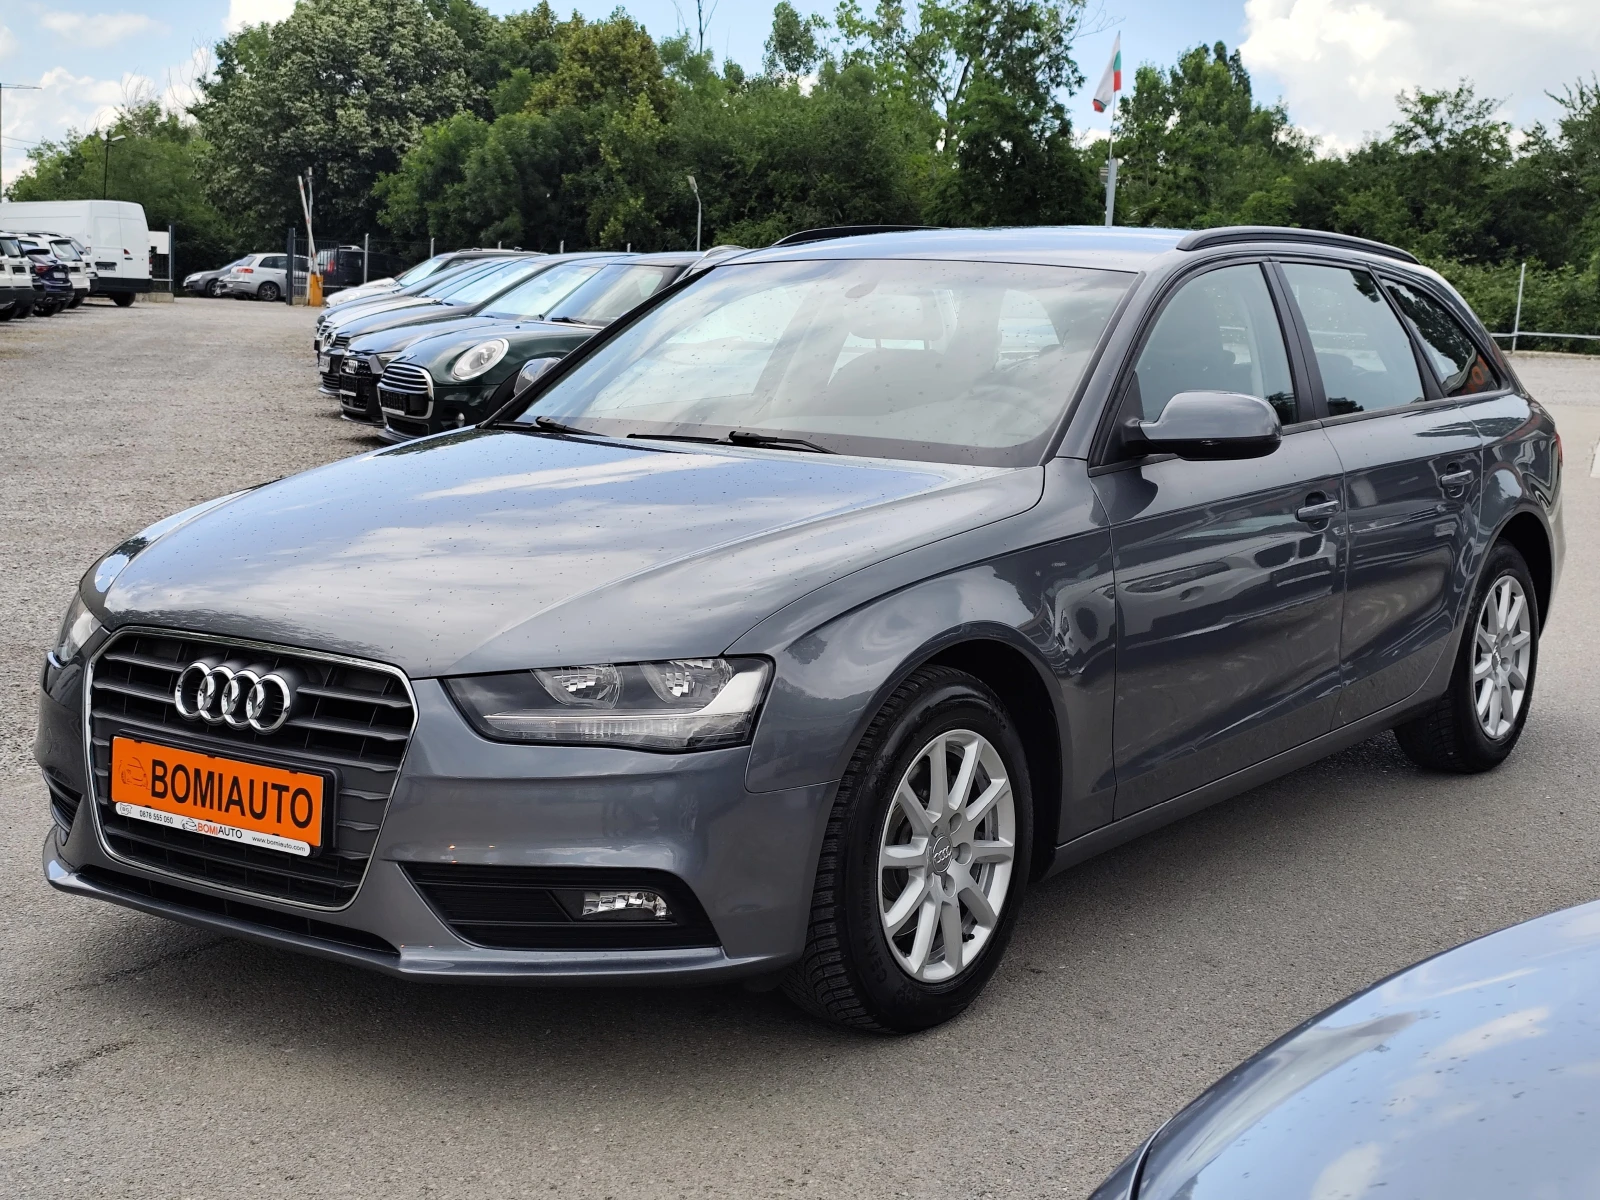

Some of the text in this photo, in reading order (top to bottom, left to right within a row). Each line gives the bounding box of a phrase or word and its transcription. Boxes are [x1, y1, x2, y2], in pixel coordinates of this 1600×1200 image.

[151, 759, 314, 829] BOMIAUTO
[153, 813, 162, 821] 555
[197, 822, 243, 839] BOMIAUTO
[252, 835, 306, 852] www.bomiauto.com
